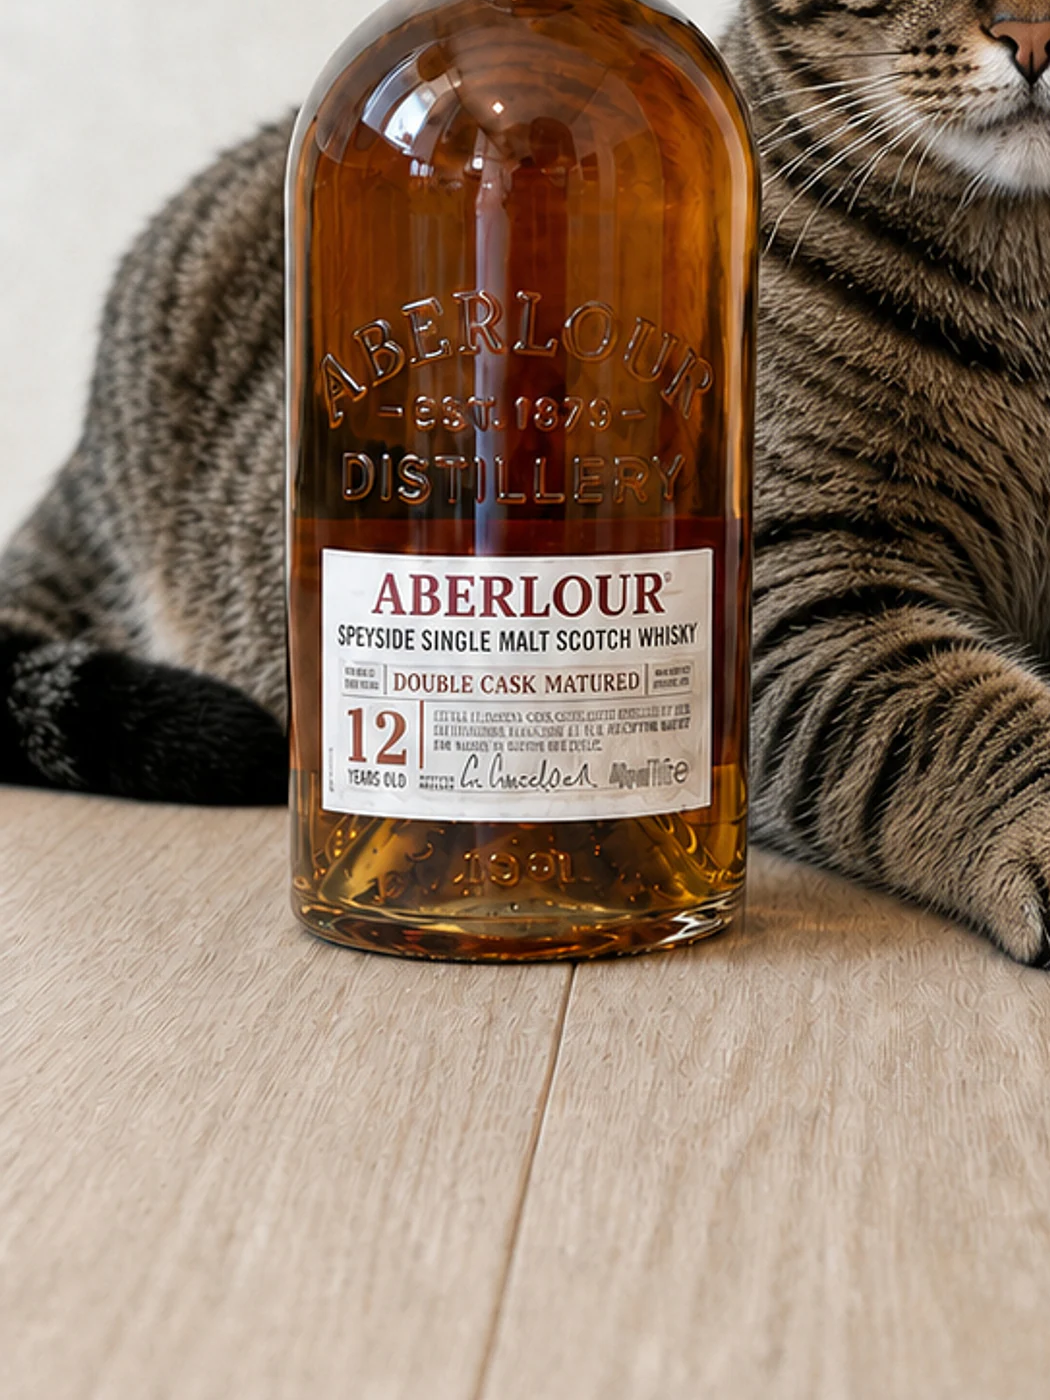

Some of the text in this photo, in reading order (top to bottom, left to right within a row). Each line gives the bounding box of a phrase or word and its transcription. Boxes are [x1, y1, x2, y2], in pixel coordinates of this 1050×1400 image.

[319, 289, 713, 427] ABERLOUR
[515, 395, 612, 433] 1879
[343, 452, 684, 504] DISTILLERY
[371, 572, 666, 618] ABERLOUR
[338, 622, 698, 653] SPEYSIDE SINGLE MALT SCOTCH WHISKY
[394, 672, 473, 694] DOUBLE
[480, 674, 537, 694] CASK
[545, 671, 640, 694] MATURED
[347, 707, 407, 766] 12
[383, 771, 407, 789] OLD
